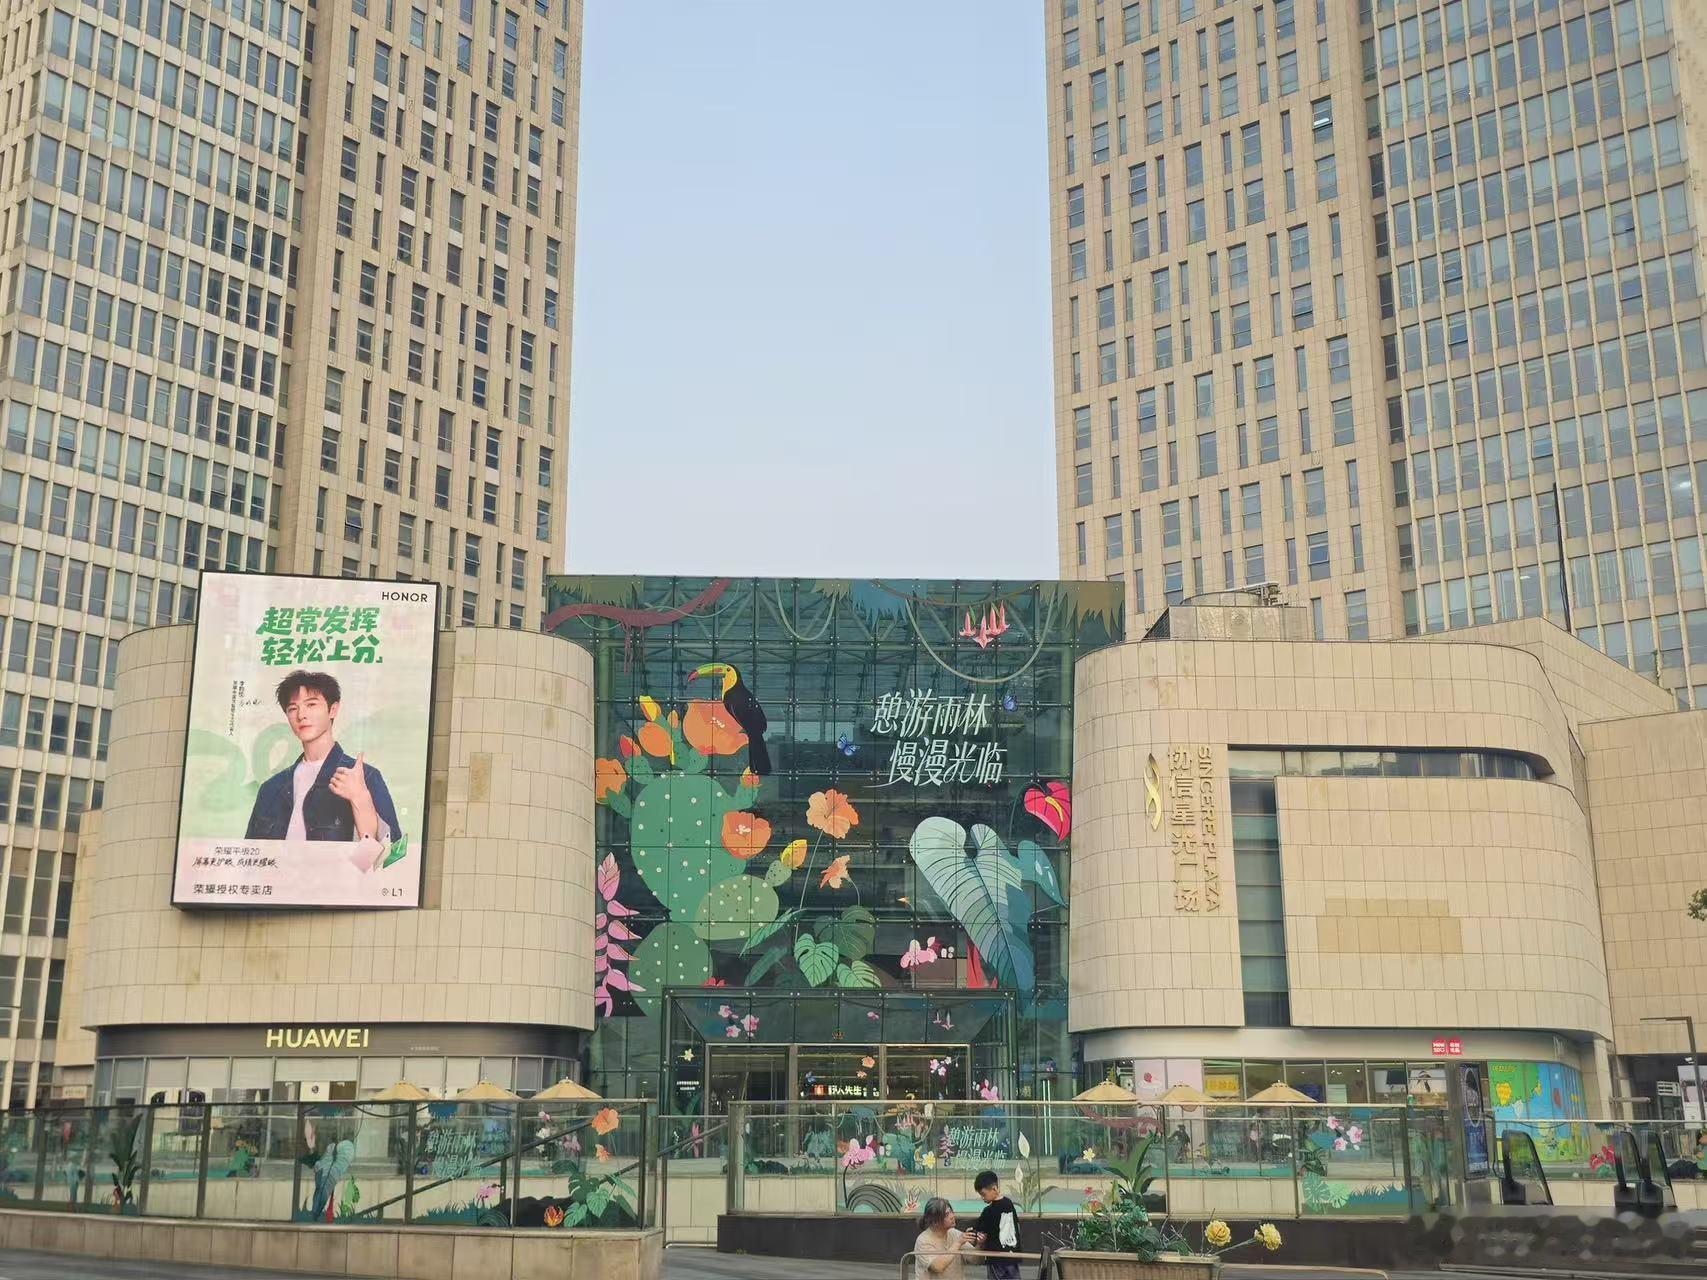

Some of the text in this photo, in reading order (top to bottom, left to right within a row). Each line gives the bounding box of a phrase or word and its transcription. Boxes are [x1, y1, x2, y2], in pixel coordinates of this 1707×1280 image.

[381, 591, 428, 602] HONOR
[256, 605, 380, 635] 超常发挥
[870, 688, 991, 738] 憩游雨林
[864, 737, 1008, 788] 慢漫光临
[1168, 746, 1200, 913] 协信星光广场
[1198, 746, 1221, 913] SINCERE PLAZA
[193, 884, 273, 896] 荣耀授权专卖店
[391, 887, 403, 897] L1
[266, 1028, 370, 1048] HUAWEI
